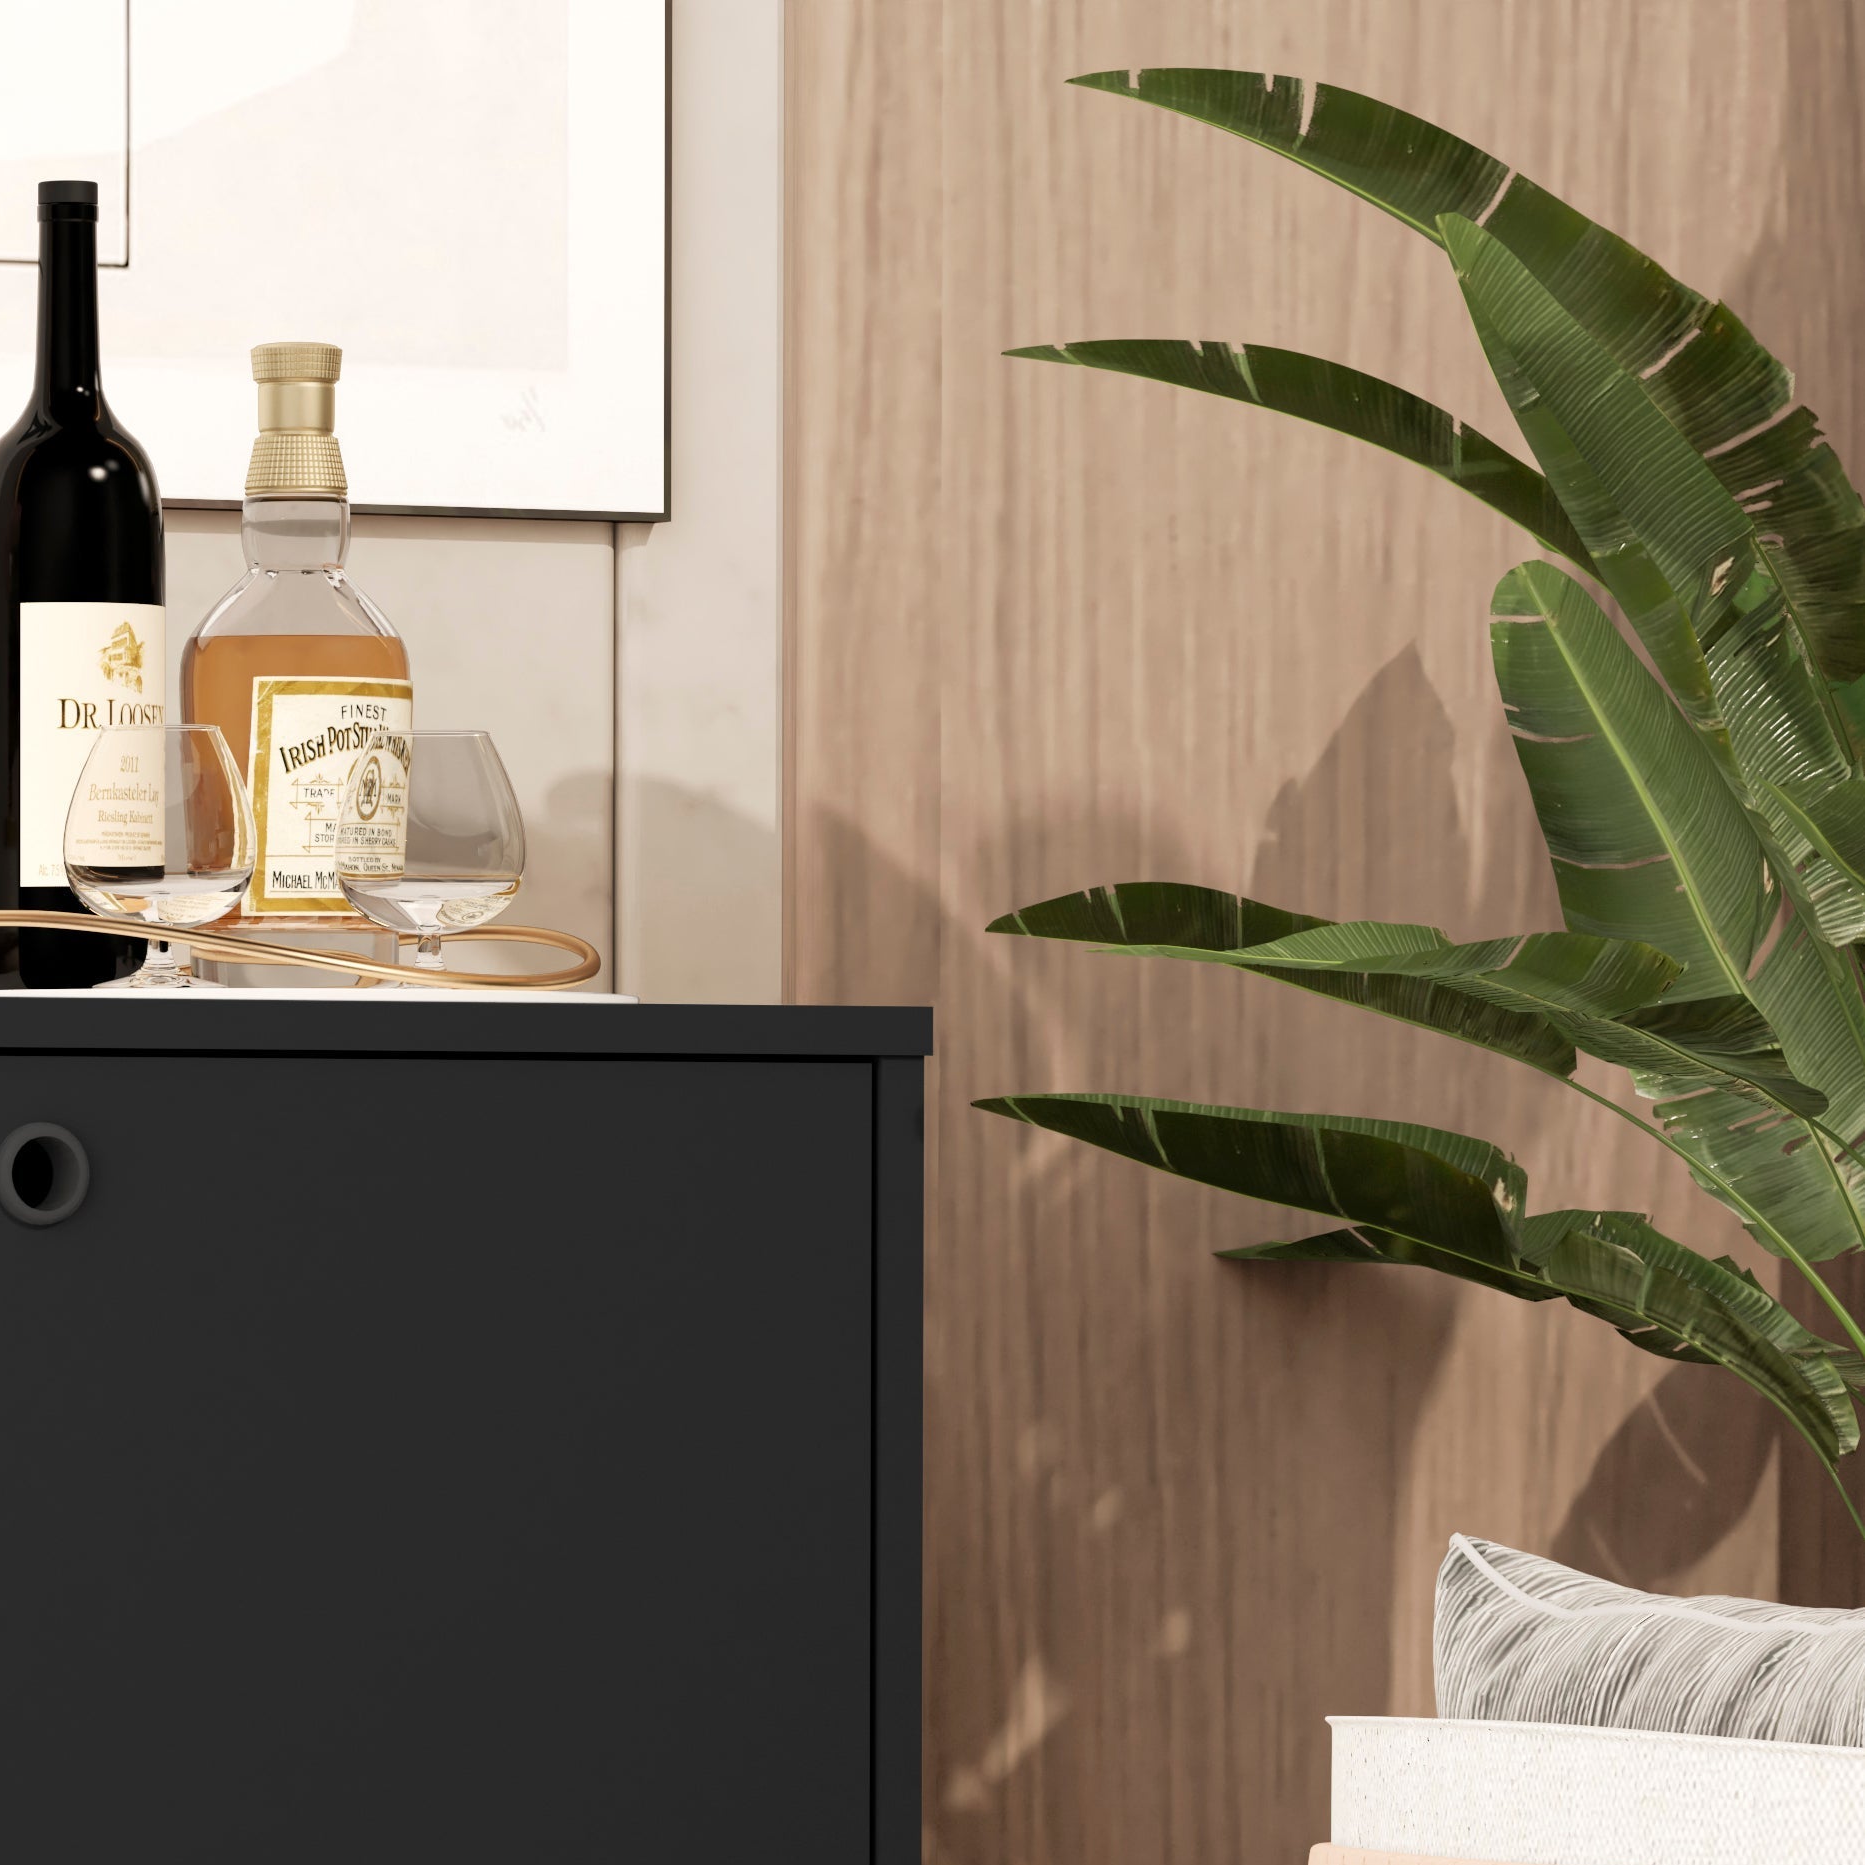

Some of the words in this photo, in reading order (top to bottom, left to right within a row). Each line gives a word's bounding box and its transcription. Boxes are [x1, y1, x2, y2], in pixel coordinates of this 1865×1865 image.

[341, 704, 387, 722] FINEST
[279, 734, 326, 774] IRISH
[327, 726, 354, 755] POT
[120, 755, 140, 773] 2011
[88, 782, 148, 801] Bernkasteler
[97, 810, 128, 825] Riesling
[272, 871, 313, 890] MICHAEL
